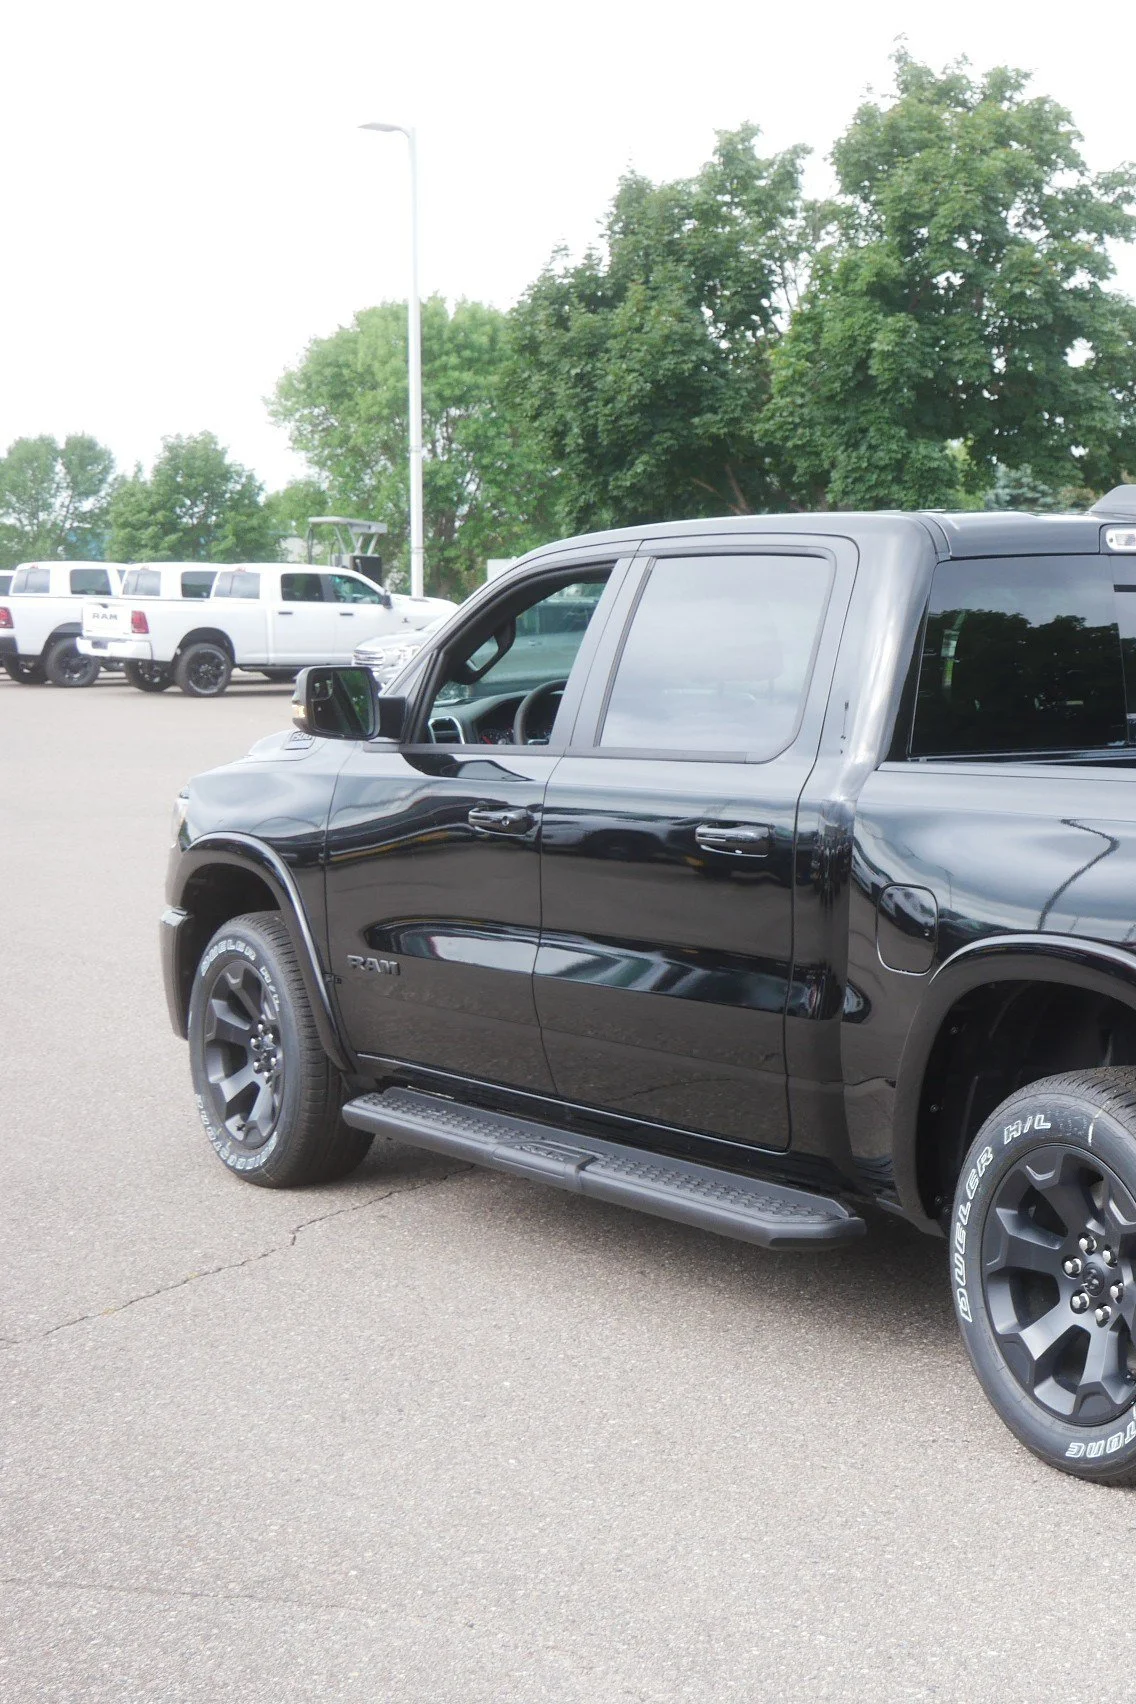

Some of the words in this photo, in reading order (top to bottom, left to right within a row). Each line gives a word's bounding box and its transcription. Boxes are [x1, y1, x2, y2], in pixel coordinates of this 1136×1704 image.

[91, 612, 118, 621] RAM
[346, 954, 401, 976] RAM
[954, 1146, 995, 1323] DUELER
[1003, 1114, 1052, 1145] H/L
